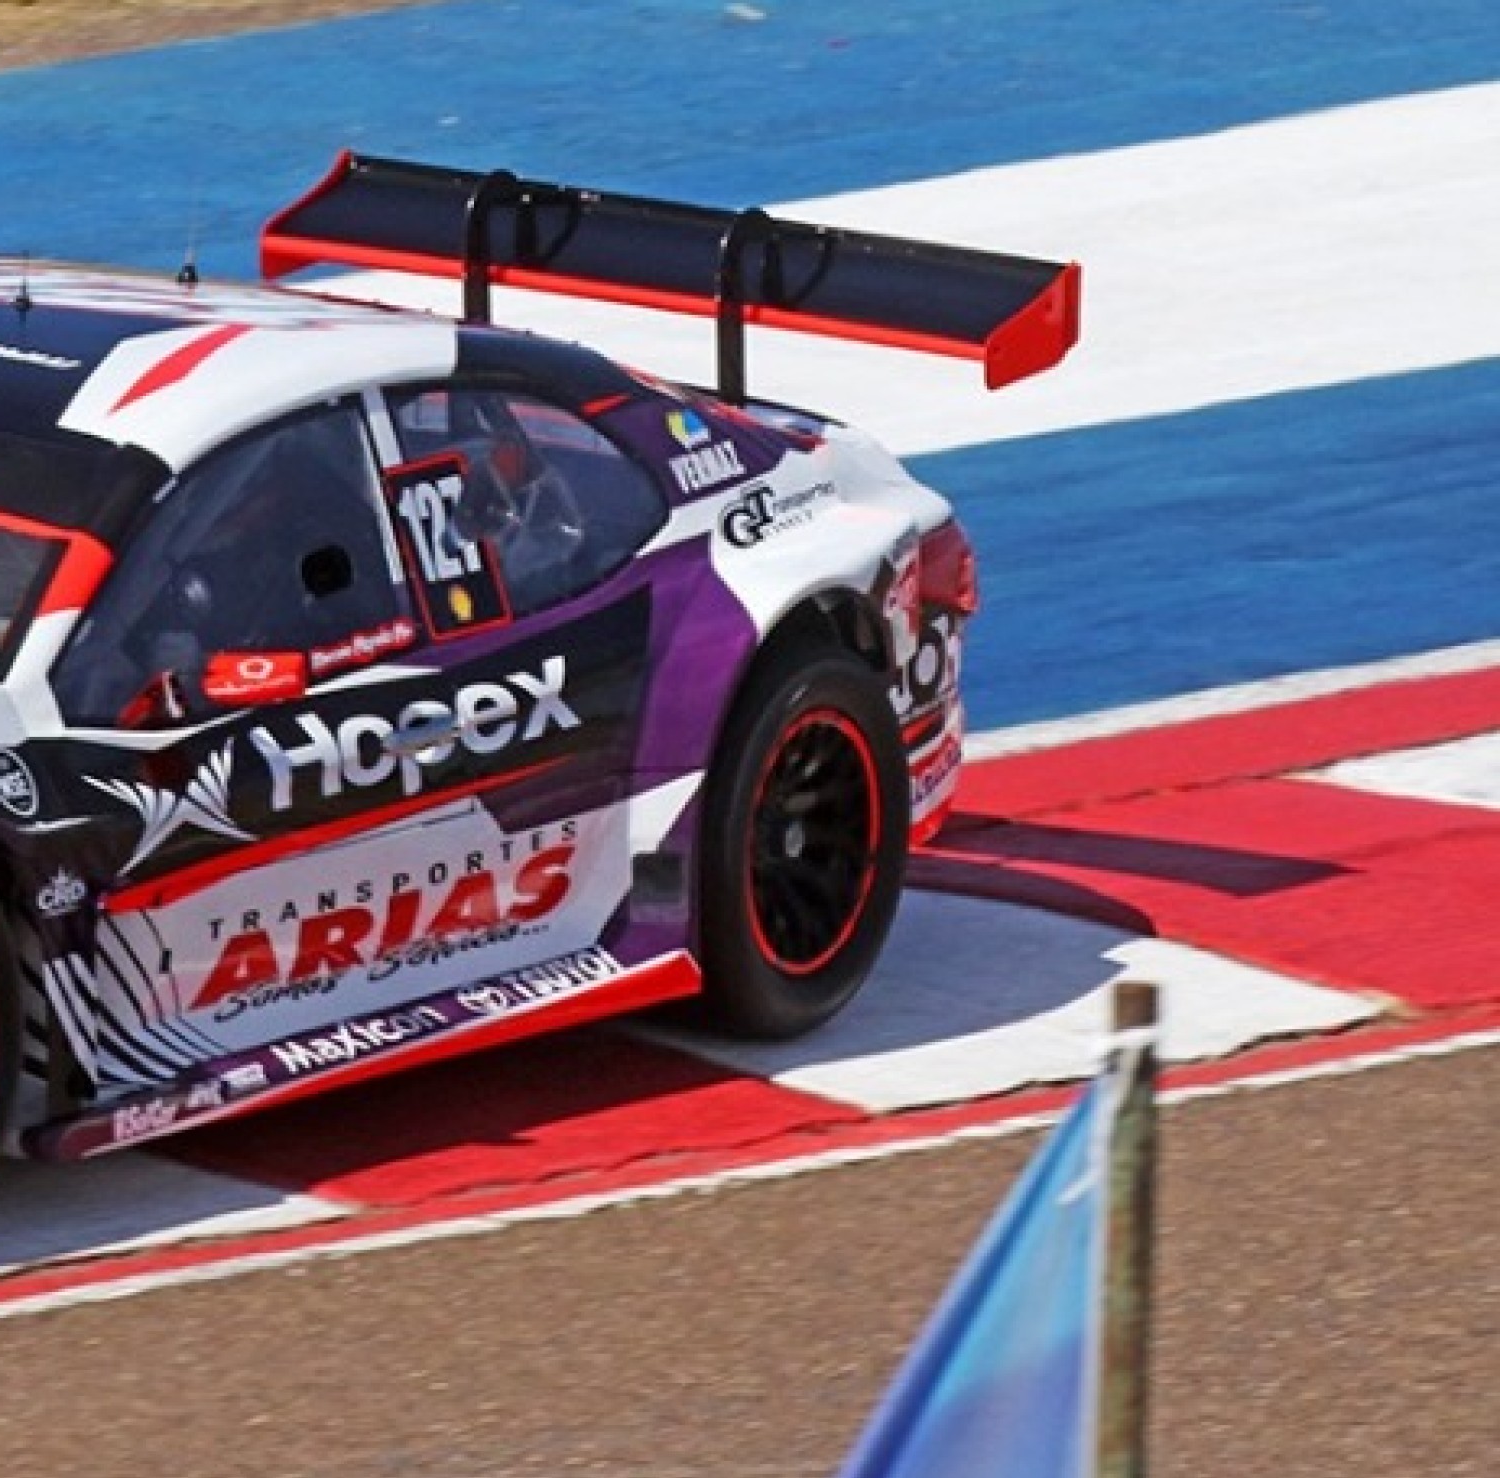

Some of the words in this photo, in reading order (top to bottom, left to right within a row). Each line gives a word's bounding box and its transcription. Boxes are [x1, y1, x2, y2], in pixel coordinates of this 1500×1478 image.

[250, 655, 581, 811] Hopex
[188, 844, 576, 1009] ARIAS
[208, 820, 578, 940] TRANSPORTES
